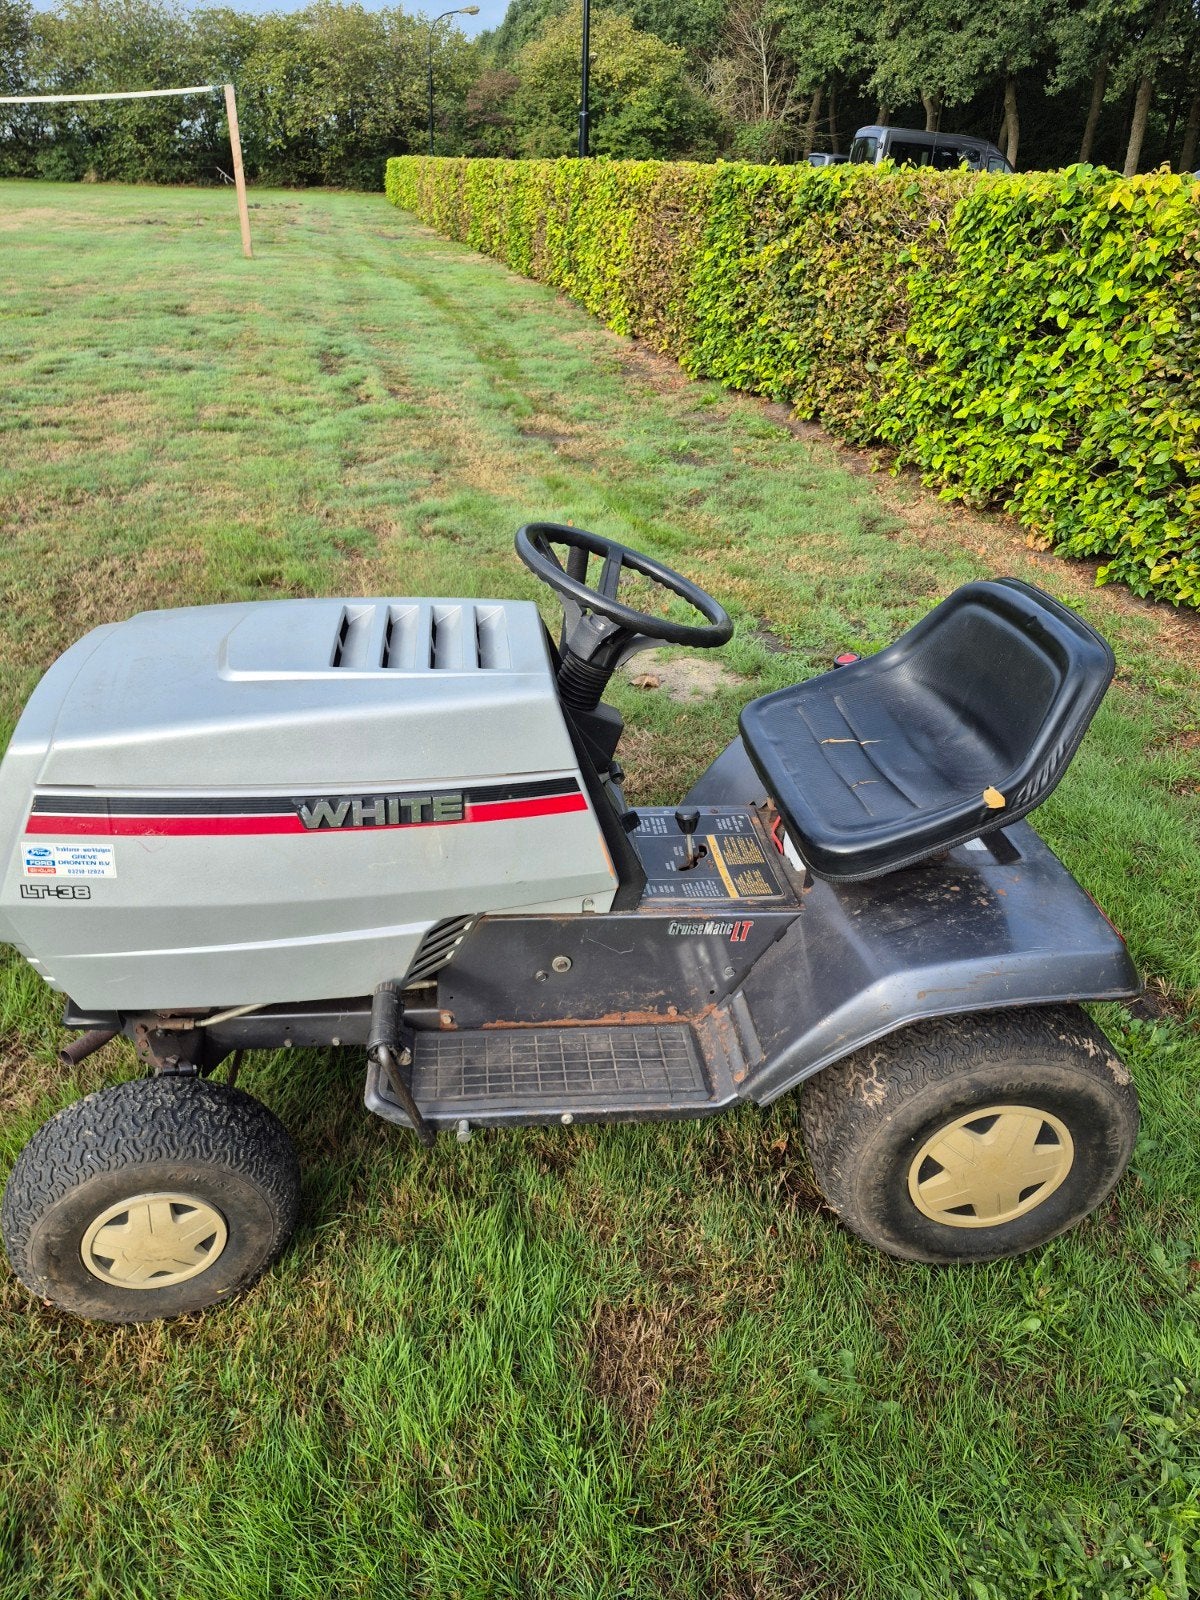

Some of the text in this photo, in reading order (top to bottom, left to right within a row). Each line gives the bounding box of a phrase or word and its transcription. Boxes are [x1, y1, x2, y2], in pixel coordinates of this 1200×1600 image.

[298, 794, 463, 829] WHITE
[20, 884, 91, 899] LT-38
[668, 920, 755, 942] CruiseMatic LT
